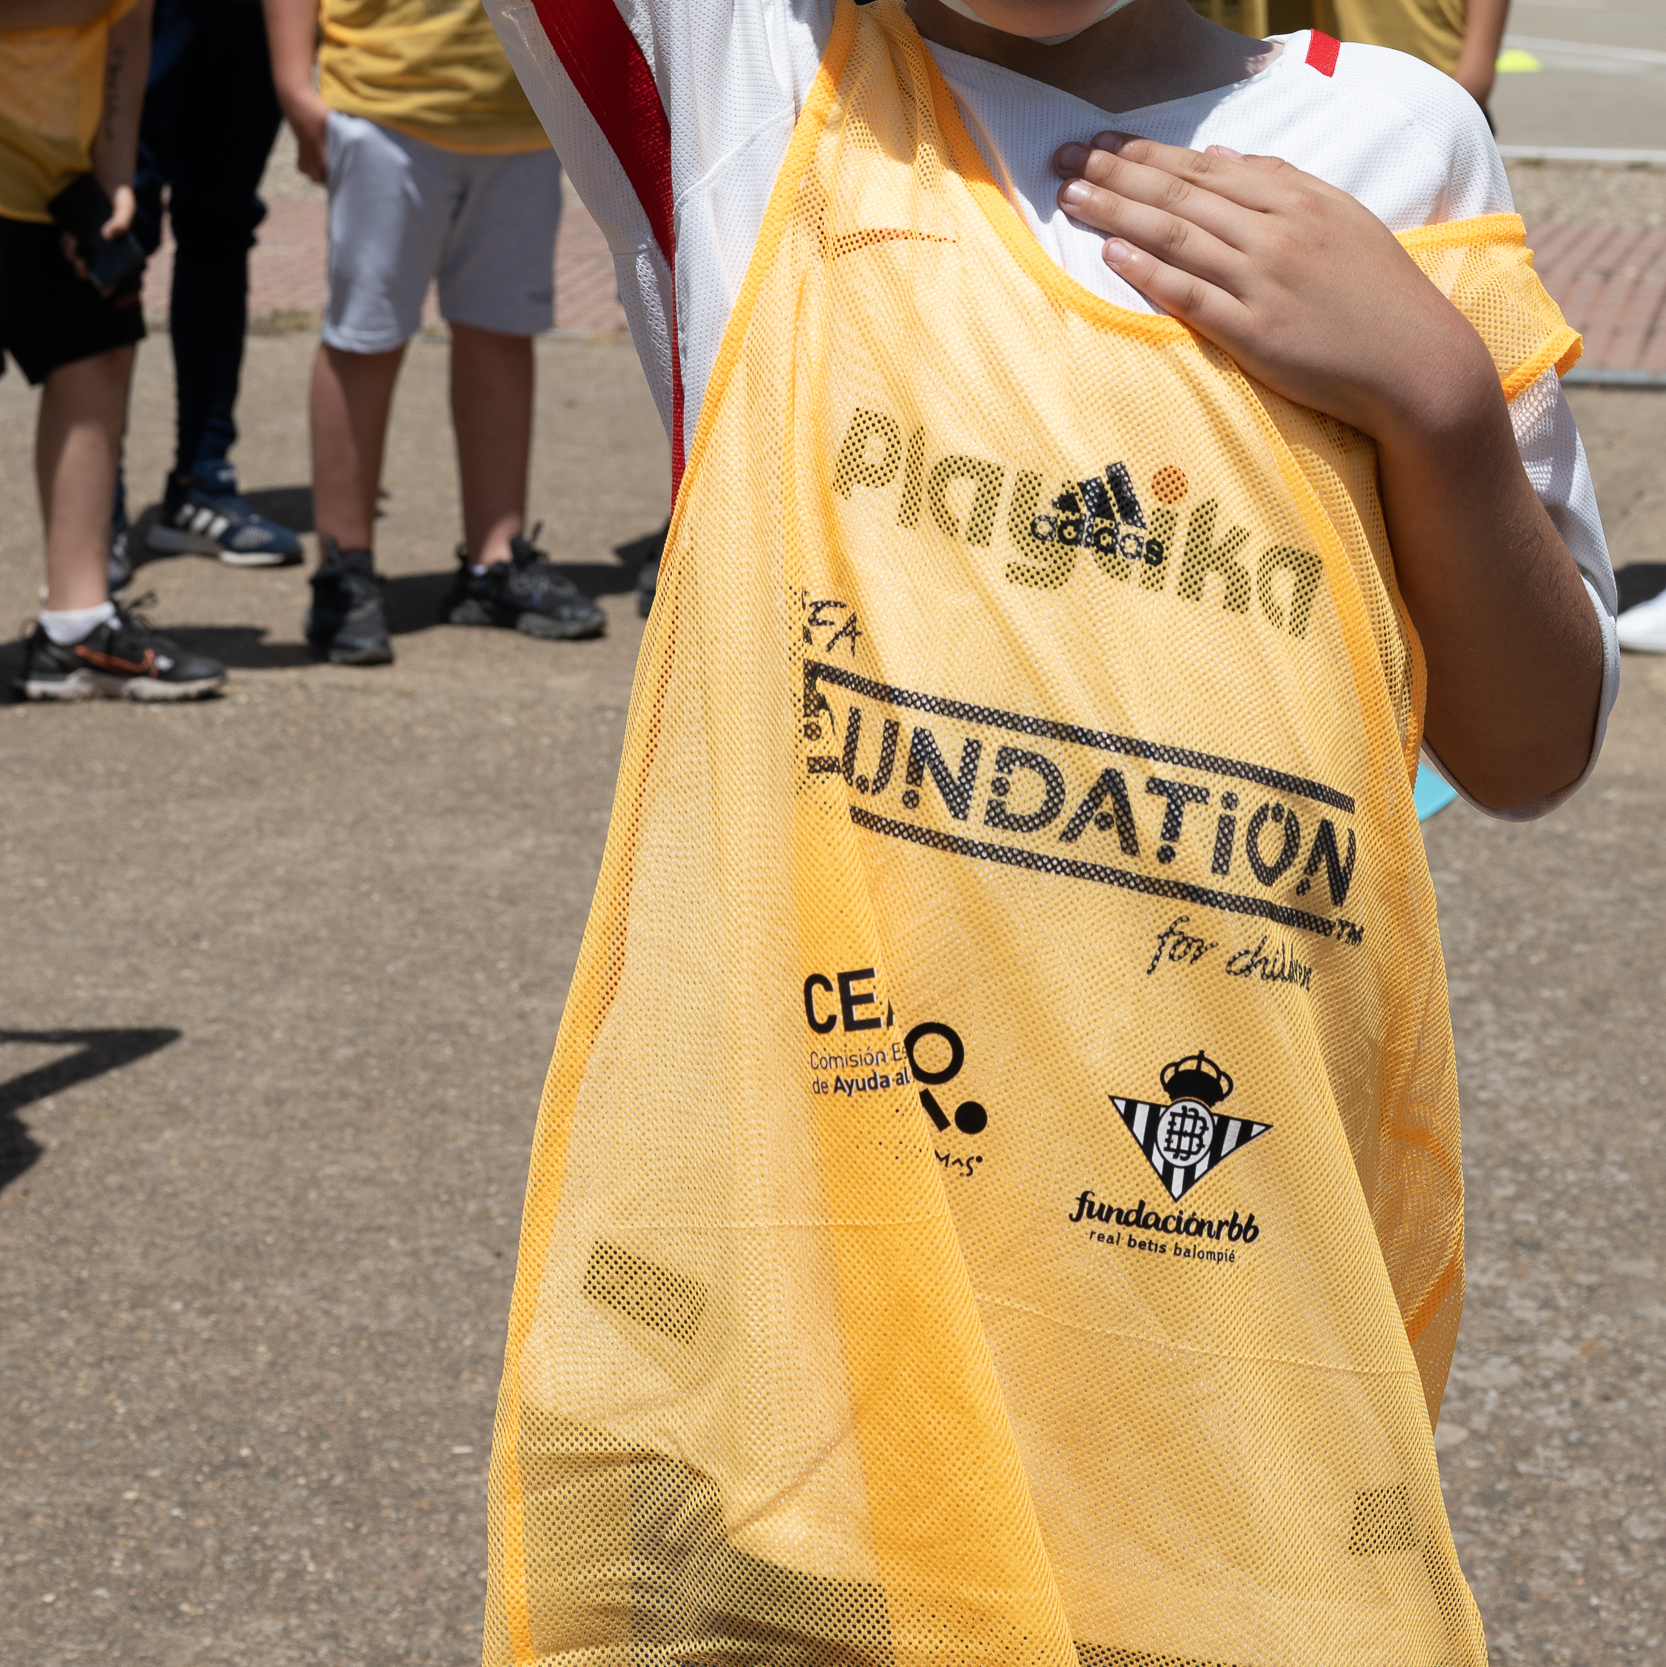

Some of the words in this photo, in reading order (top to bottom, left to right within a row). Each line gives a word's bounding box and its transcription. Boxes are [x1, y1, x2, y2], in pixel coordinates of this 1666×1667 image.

[1030, 511, 1165, 568] adidas
[1146, 915, 1219, 975] for
[810, 1044, 887, 1070] Comisión
[812, 1076, 829, 1095] de
[834, 1069, 891, 1097] Ayuda
[895, 1066, 911, 1086] al
[1068, 1190, 1260, 1244] fundaciónrbb
[1089, 1230, 1121, 1246] real
[1127, 1234, 1167, 1254] betis
[1173, 1242, 1236, 1265] balompié
